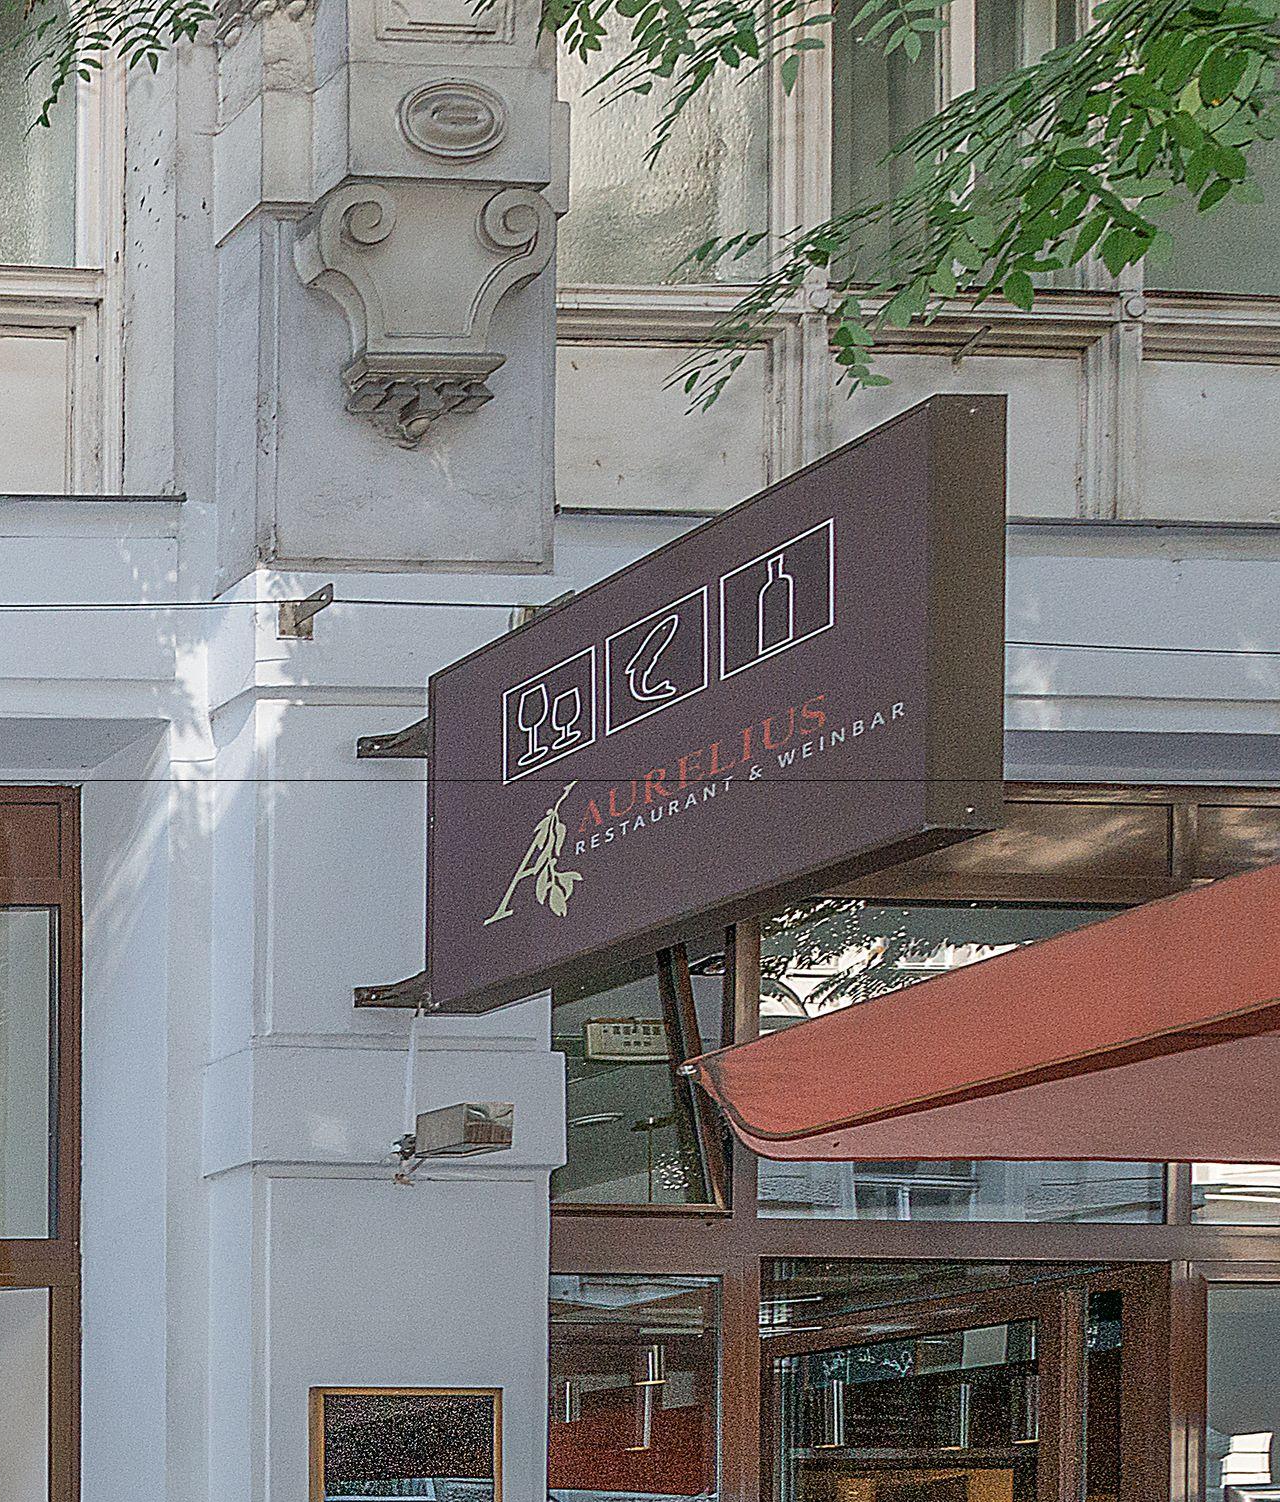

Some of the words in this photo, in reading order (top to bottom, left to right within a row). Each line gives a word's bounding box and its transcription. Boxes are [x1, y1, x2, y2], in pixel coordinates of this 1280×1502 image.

[574, 775, 733, 856] RESTAURANT
[748, 765, 763, 781] &
[777, 701, 907, 769] WEINBAR
[577, 694, 828, 833] AURELIUS
